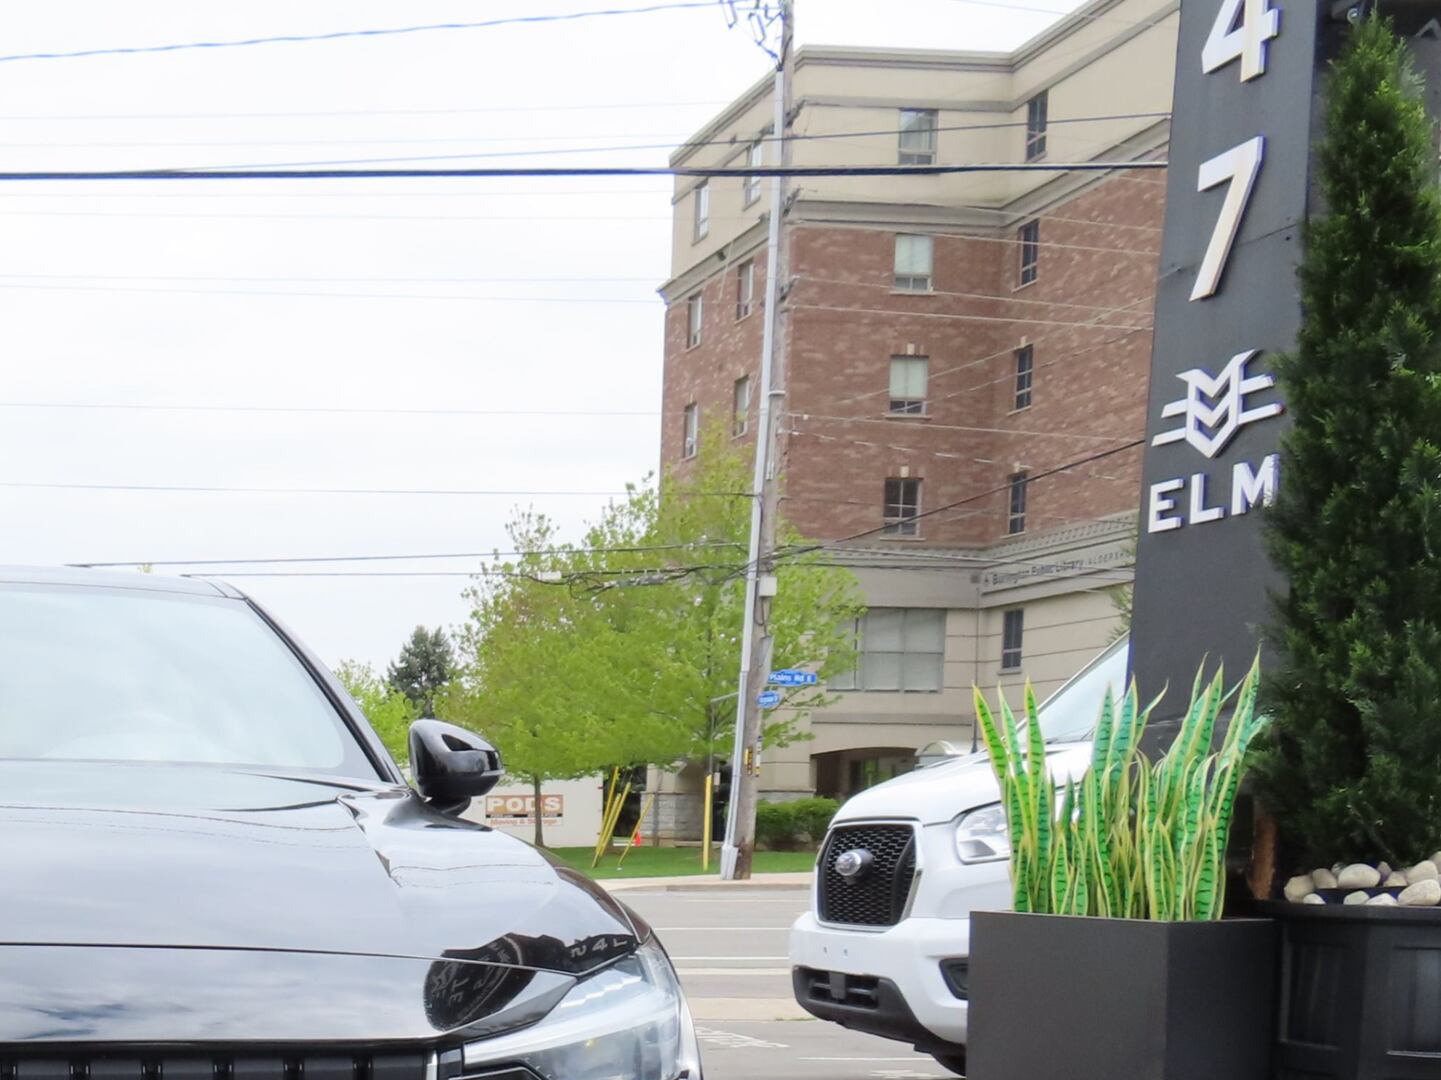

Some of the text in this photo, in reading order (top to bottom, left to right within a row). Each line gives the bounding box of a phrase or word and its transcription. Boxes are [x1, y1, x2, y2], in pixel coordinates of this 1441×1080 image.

[1201, 0, 1280, 83] 4
[1189, 135, 1267, 302] 7
[1148, 453, 1281, 534] ELM
